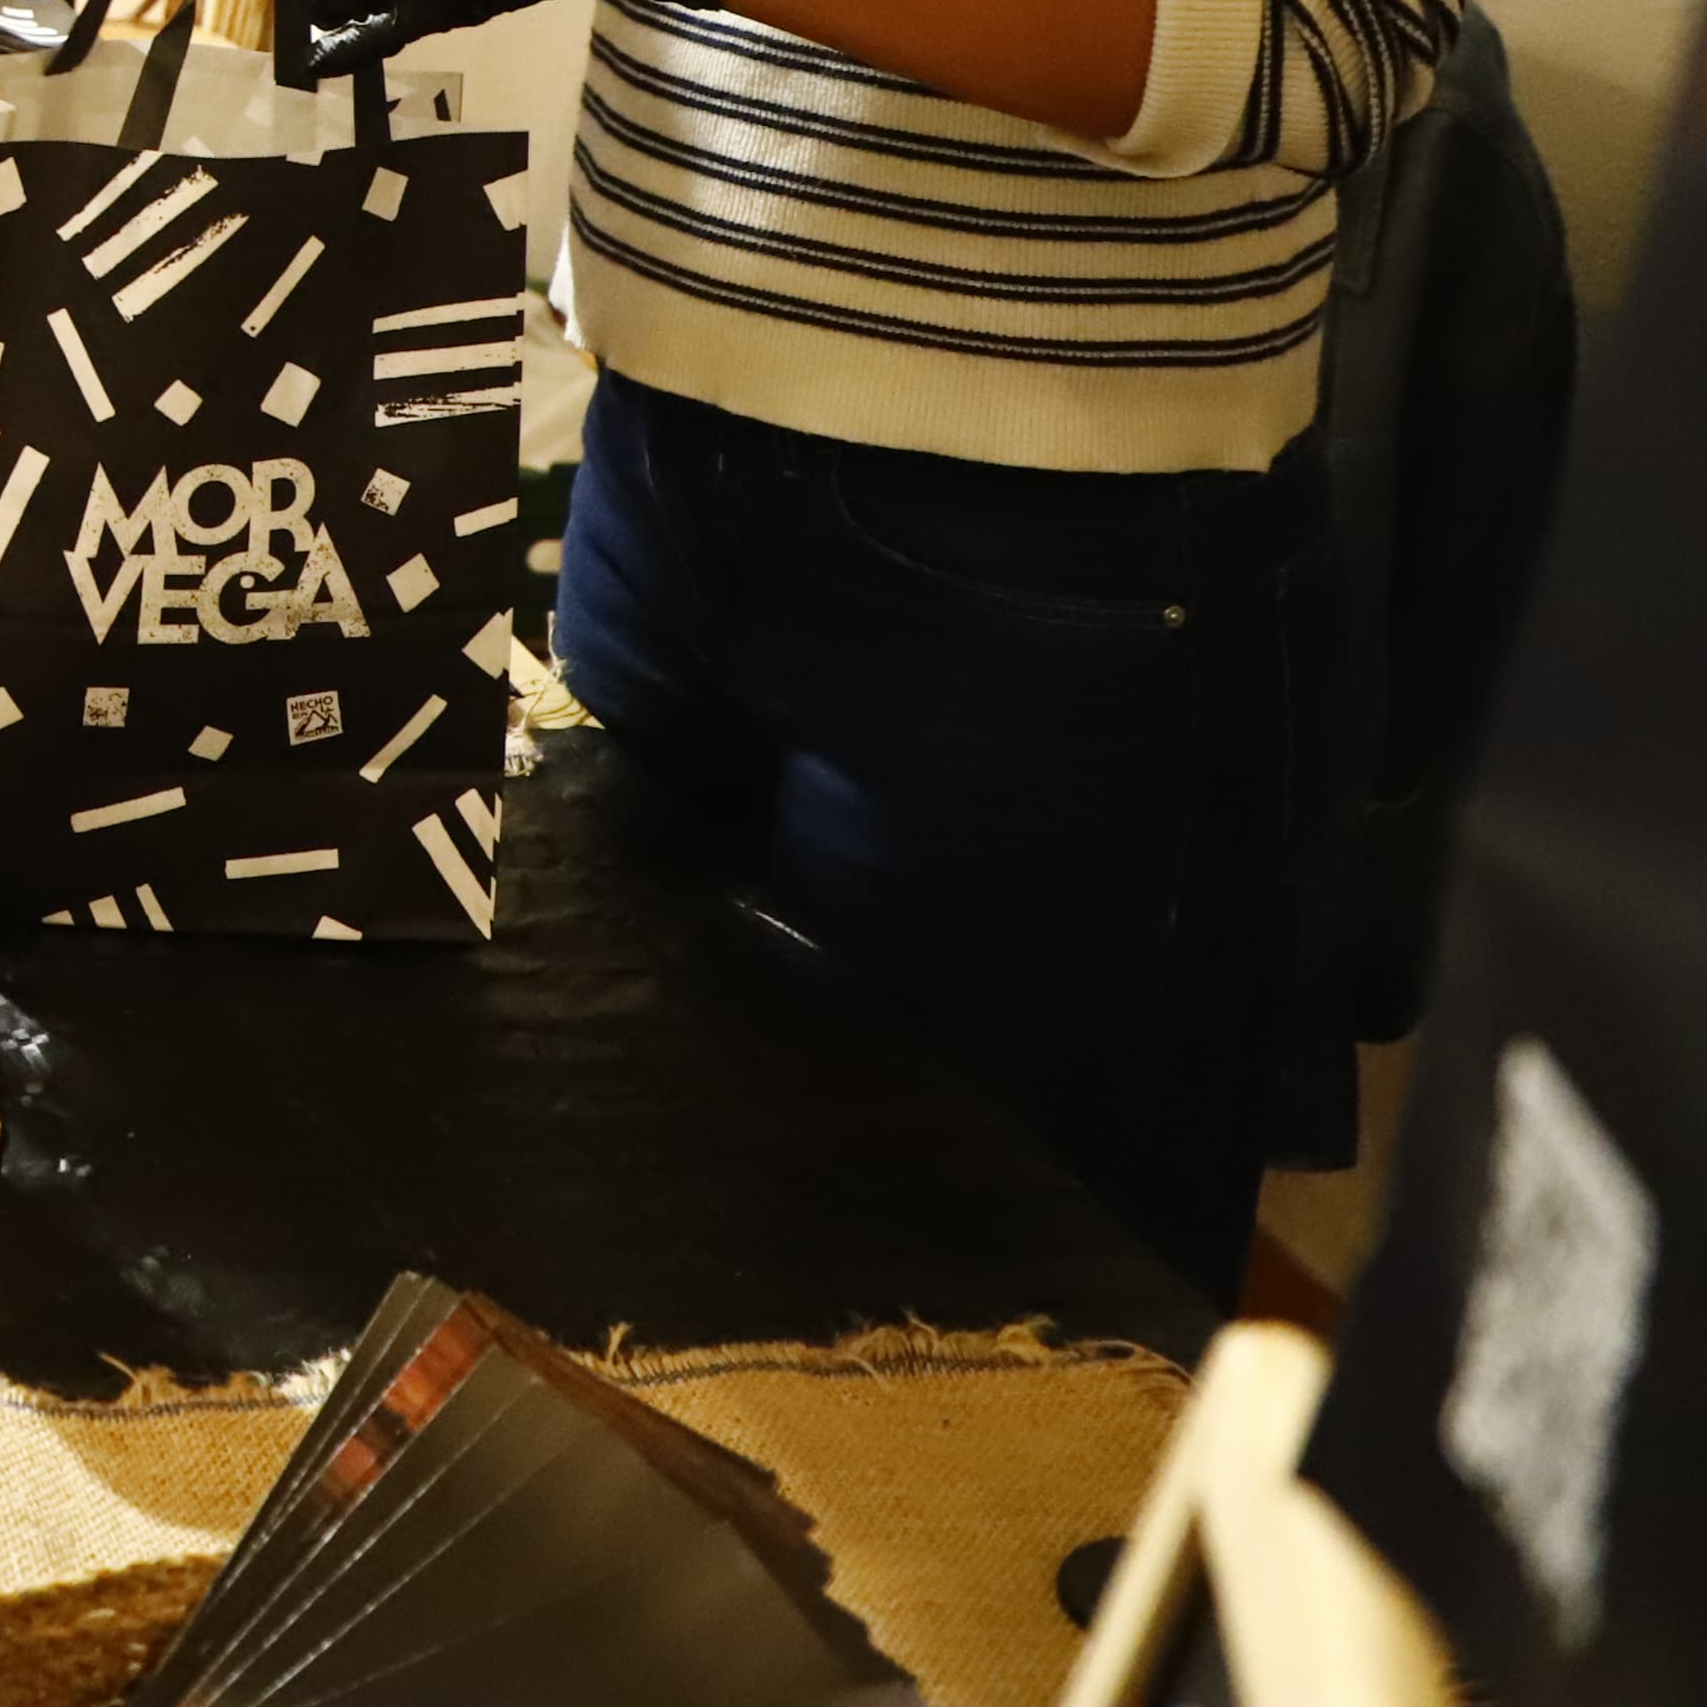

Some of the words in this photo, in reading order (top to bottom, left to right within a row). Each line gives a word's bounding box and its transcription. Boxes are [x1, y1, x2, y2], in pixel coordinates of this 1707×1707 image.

[72, 457, 318, 558] MOR
[63, 523, 371, 646] VEGA
[290, 695, 334, 712] HECHO
